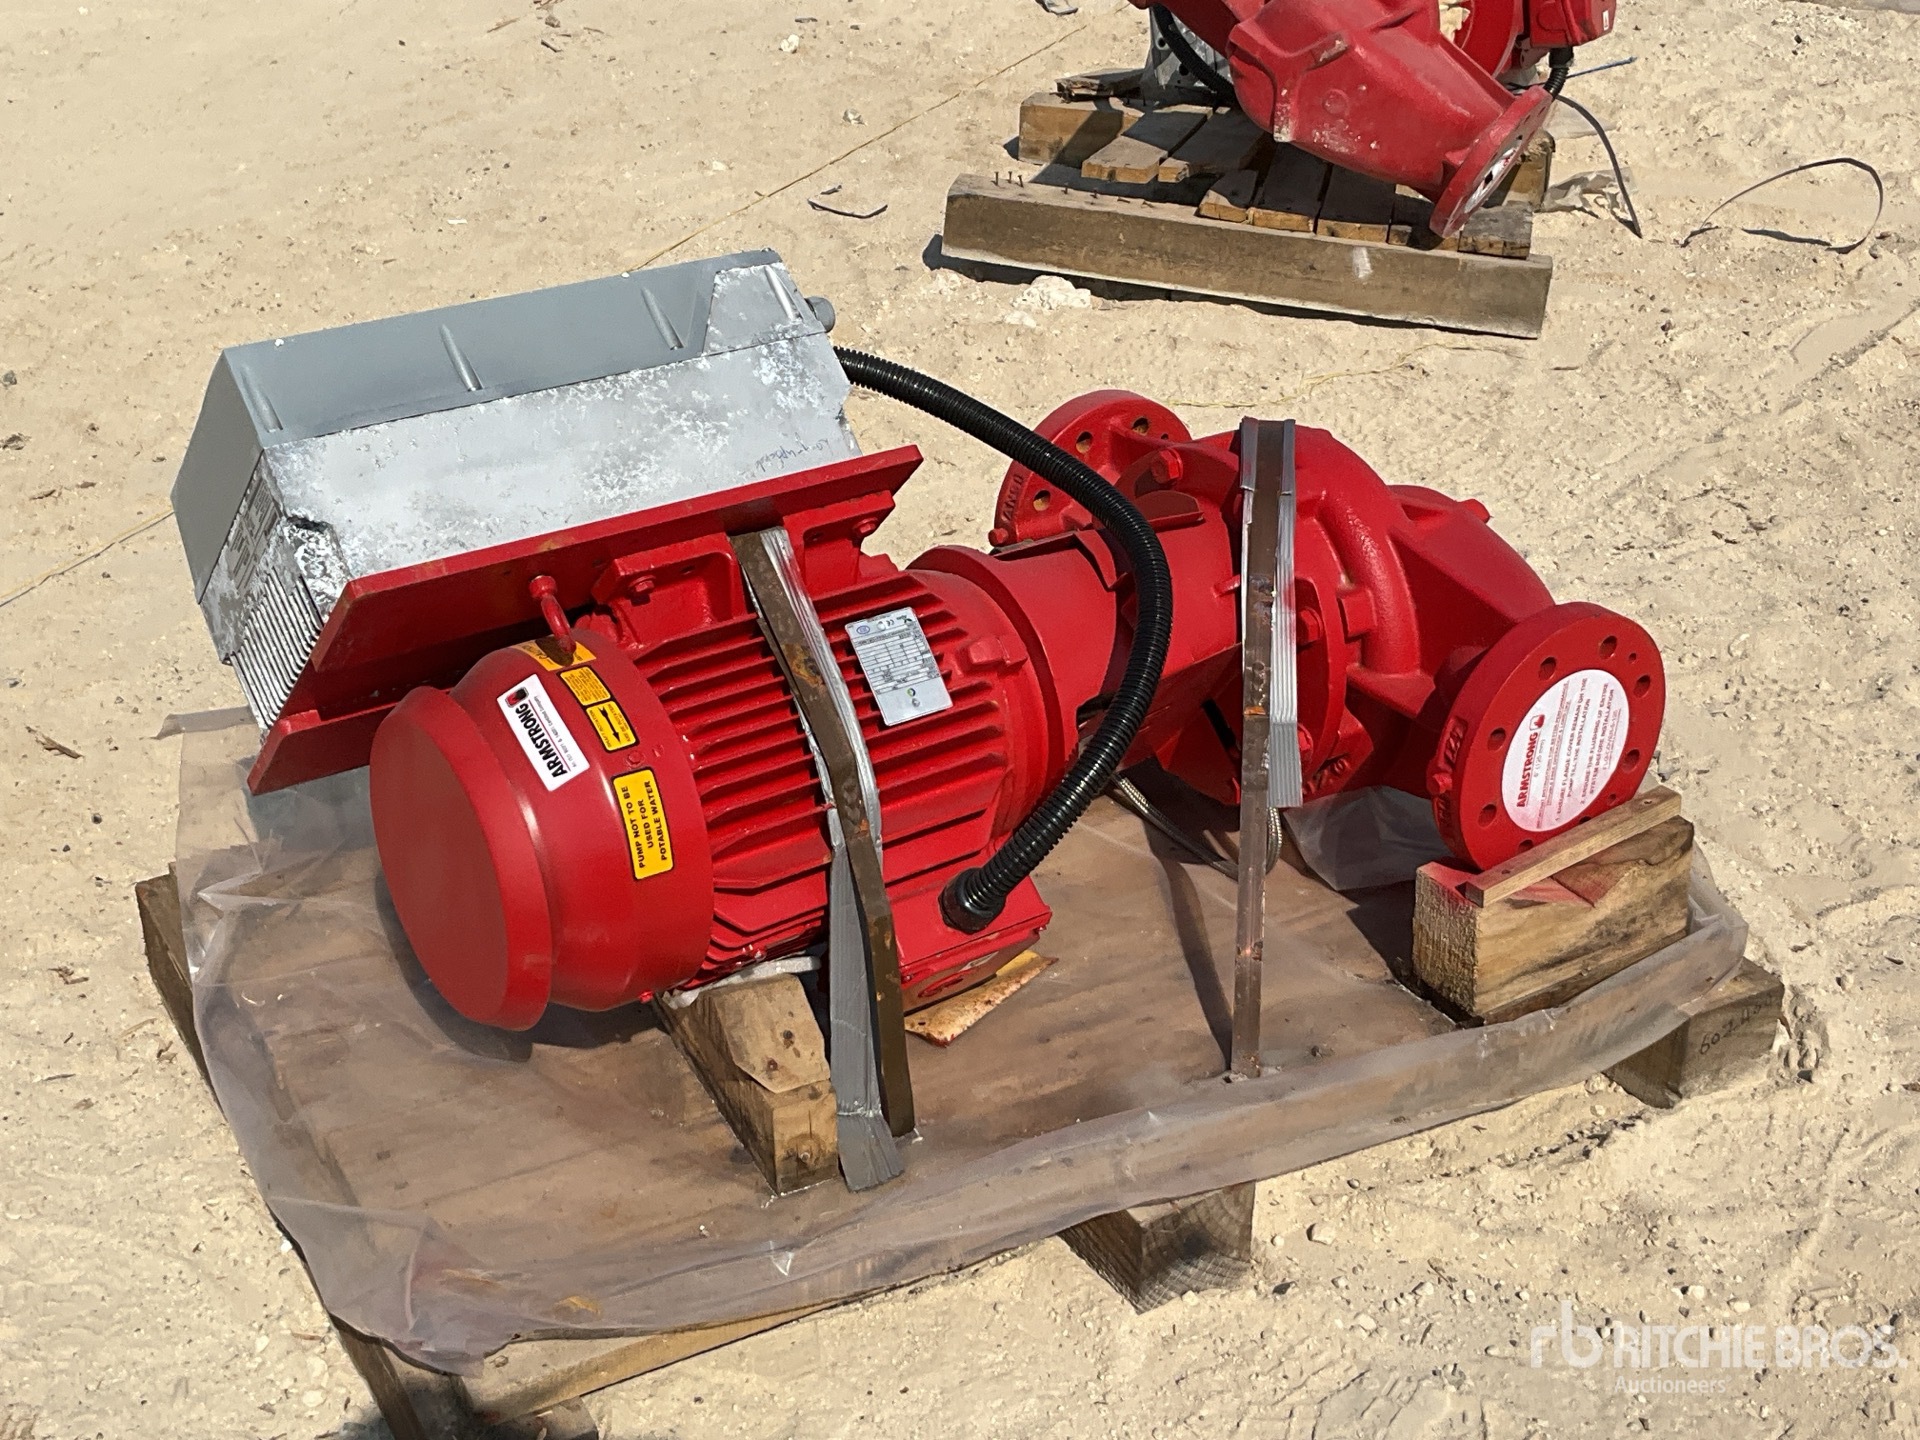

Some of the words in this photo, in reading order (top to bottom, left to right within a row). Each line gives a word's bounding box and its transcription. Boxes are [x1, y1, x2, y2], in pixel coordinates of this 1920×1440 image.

[1600, 682, 1609, 707] ENTIRE
[1577, 698, 1591, 745] INSTALLATION
[1598, 709, 1604, 718] OF
[516, 702, 568, 778] ARMSTRONG
[1550, 723, 1558, 744] BETTER
[1590, 719, 1602, 753] FLUSHING
[1590, 767, 1600, 793] SYSTEM
[1595, 738, 1605, 765] BEFORE
[1601, 689, 1615, 736] INSTALLATION
[1557, 788, 1566, 813] ENSURE
[1562, 758, 1572, 785] FLANGE
[1567, 732, 1576, 756] COVER
[1572, 704, 1582, 730] REMAIN
[1578, 693, 1585, 702] ON
[1587, 755, 1595, 768] THE
[1516, 732, 1538, 807] ARMSTRONG
[621, 786, 630, 799] BE
[1582, 770, 1591, 797] ENSURE
[628, 802, 636, 815] TO
[638, 800, 647, 820] FOR
[644, 781, 659, 814] WATER
[630, 819, 640, 838] NOT
[645, 821, 654, 848] USED
[653, 817, 667, 861] POTABLE
[633, 842, 645, 868] PUMP
